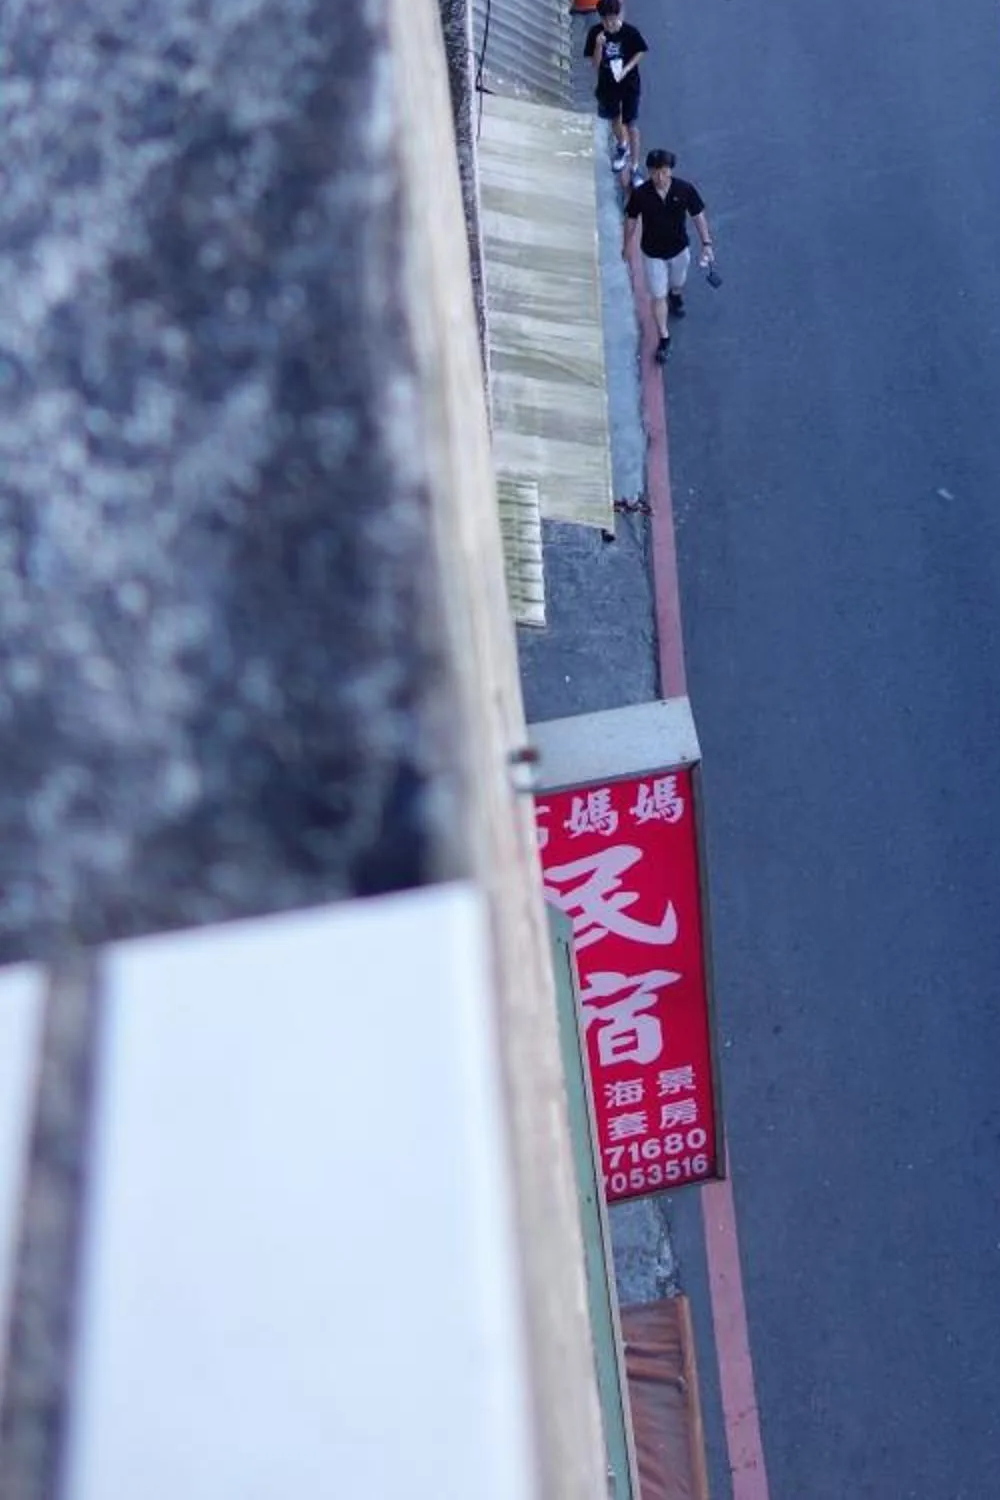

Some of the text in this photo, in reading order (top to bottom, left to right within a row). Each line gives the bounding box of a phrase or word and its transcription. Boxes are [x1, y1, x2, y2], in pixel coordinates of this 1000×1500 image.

[604, 1064, 697, 1109] 海景
[607, 1098, 699, 1142] 套房
[603, 1153, 708, 1194] 053516
